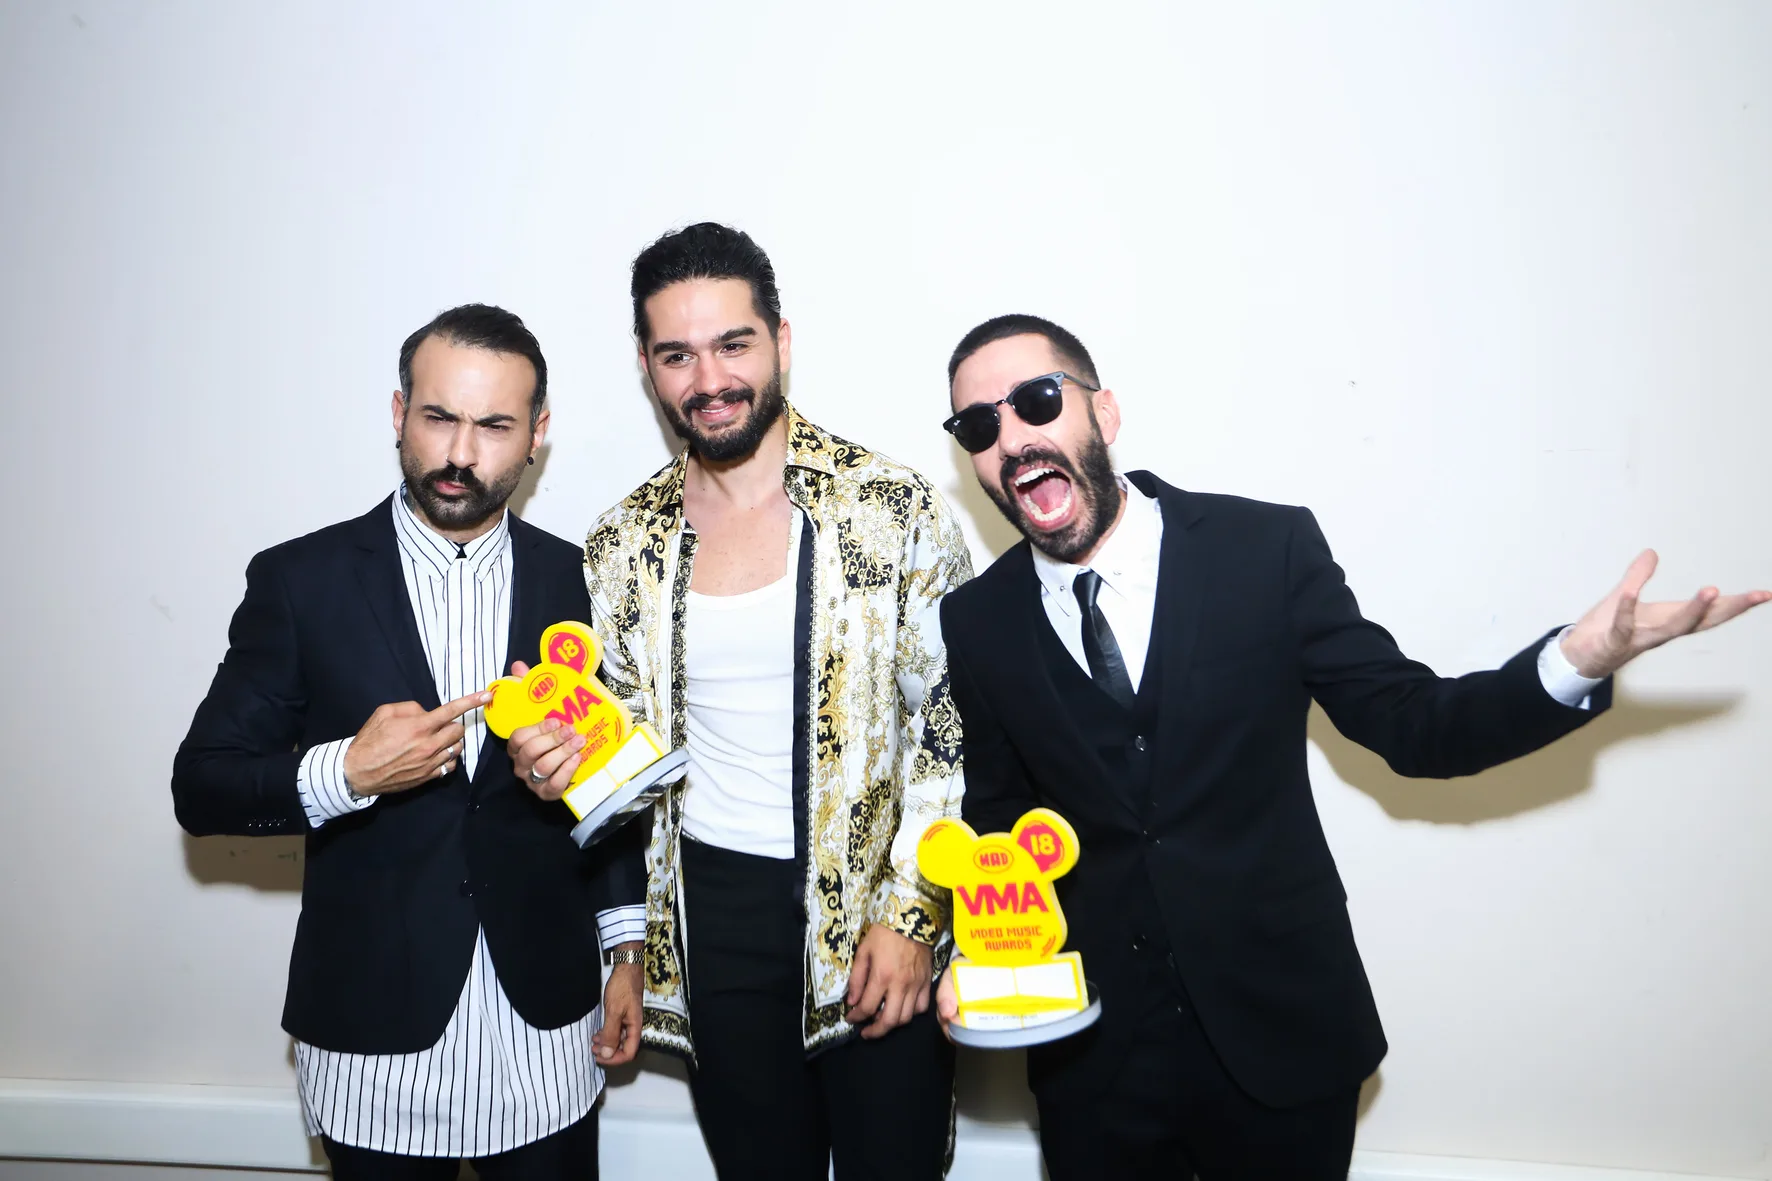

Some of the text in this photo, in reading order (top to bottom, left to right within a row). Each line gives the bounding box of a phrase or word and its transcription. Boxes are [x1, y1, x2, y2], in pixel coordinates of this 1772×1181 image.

[556, 638, 580, 663] 18
[532, 677, 554, 700] MAD
[543, 685, 603, 728] MA
[579, 734, 608, 766] WARDS
[1030, 833, 1056, 856] 18
[980, 852, 1008, 867] MAD
[956, 881, 1049, 916] VMA
[970, 925, 1042, 939] VIDEO MUSIC
[984, 938, 1032, 951] AWARDS
